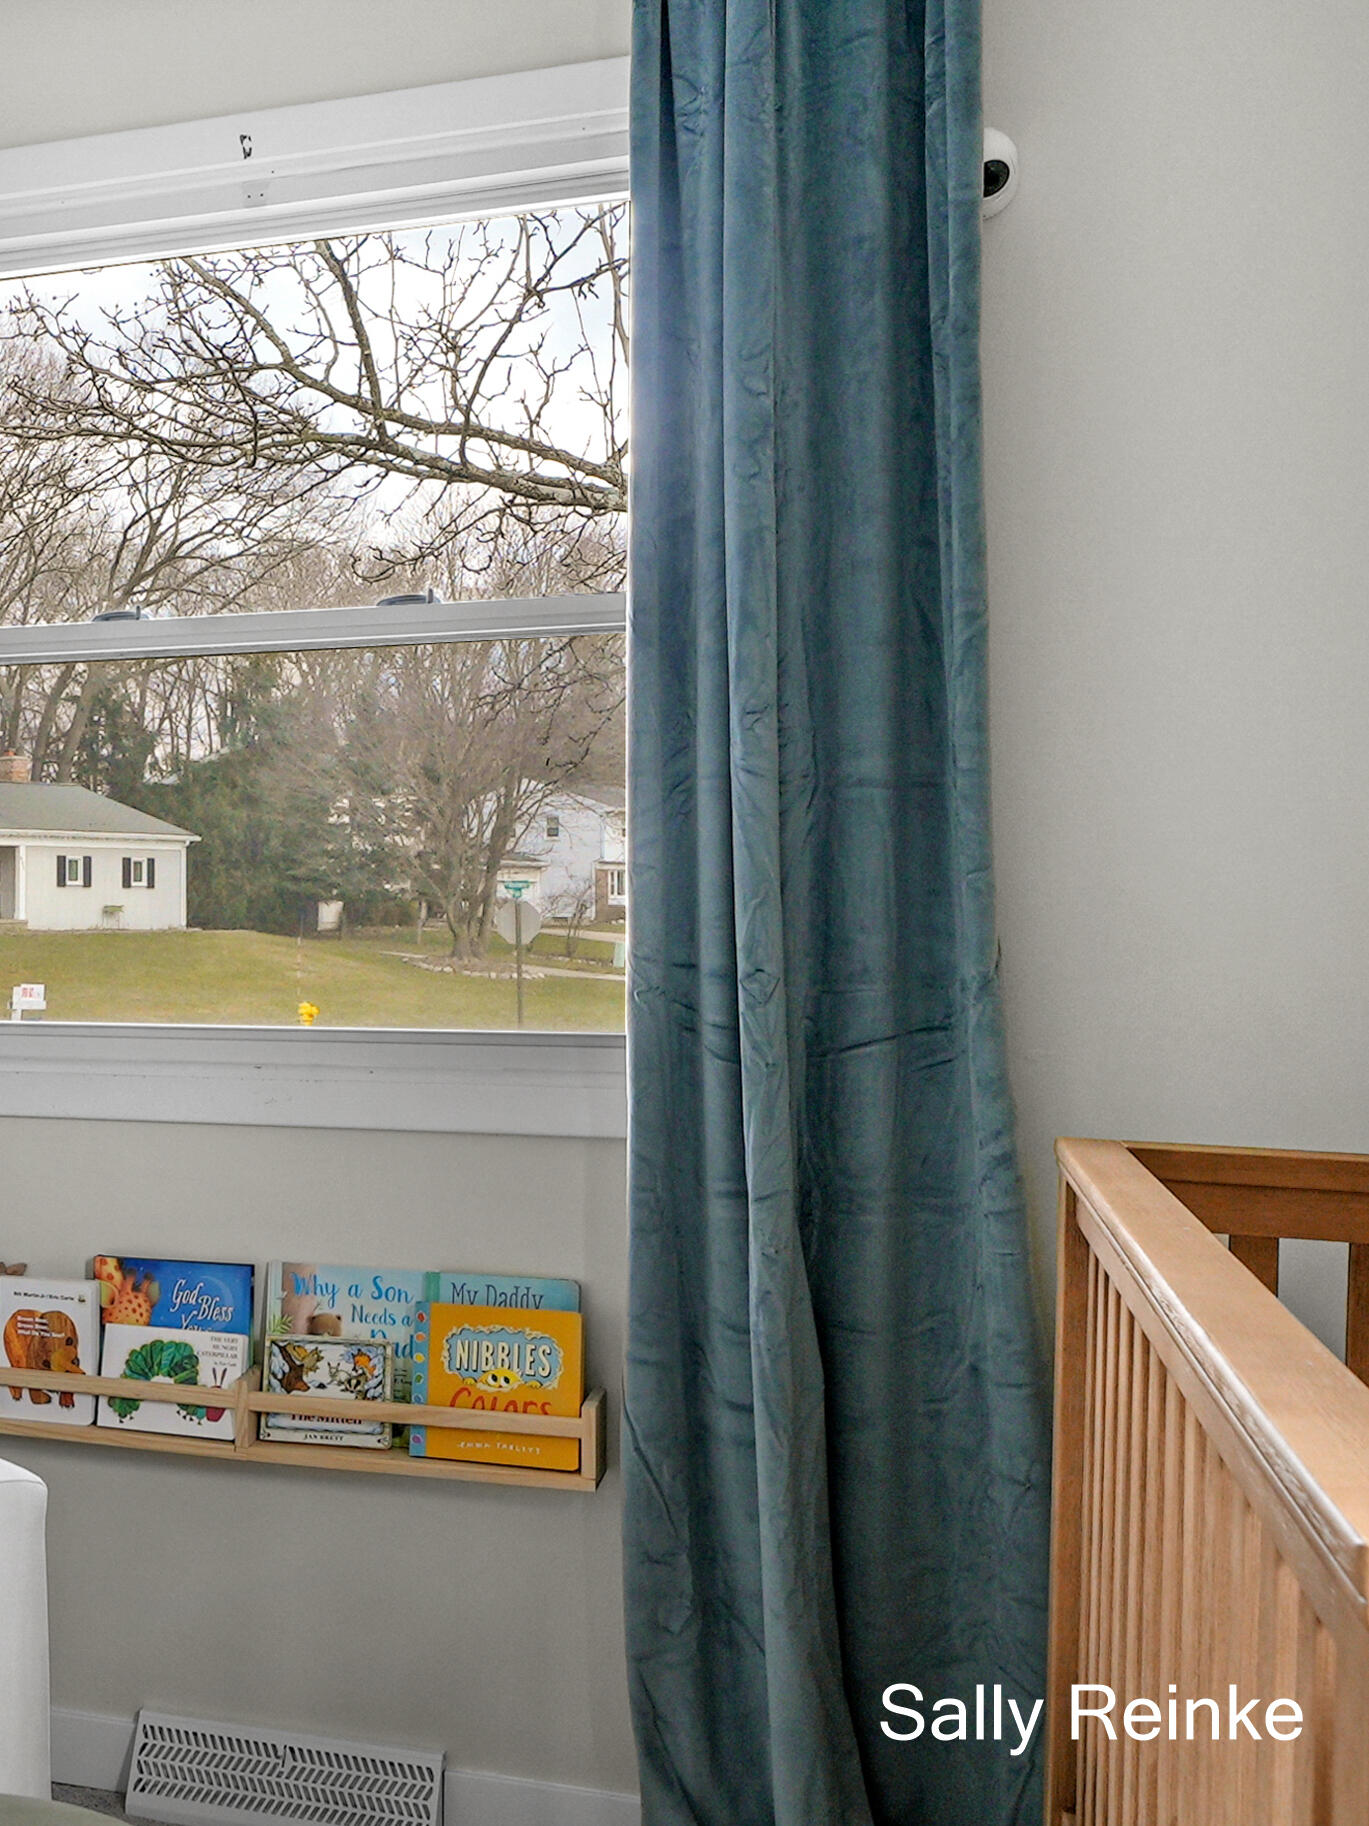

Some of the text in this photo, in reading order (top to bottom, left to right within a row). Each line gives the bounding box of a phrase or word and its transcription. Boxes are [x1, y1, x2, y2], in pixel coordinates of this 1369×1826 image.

[169, 1279, 204, 1312] God
[197, 1295, 234, 1322] Bless
[291, 1271, 414, 1309] Why a Son
[451, 1281, 545, 1310] My Daddy
[350, 1303, 413, 1327] Needs a
[456, 1339, 552, 1378] NIBBLES
[303, 1433, 344, 1442] JAN BRETT
